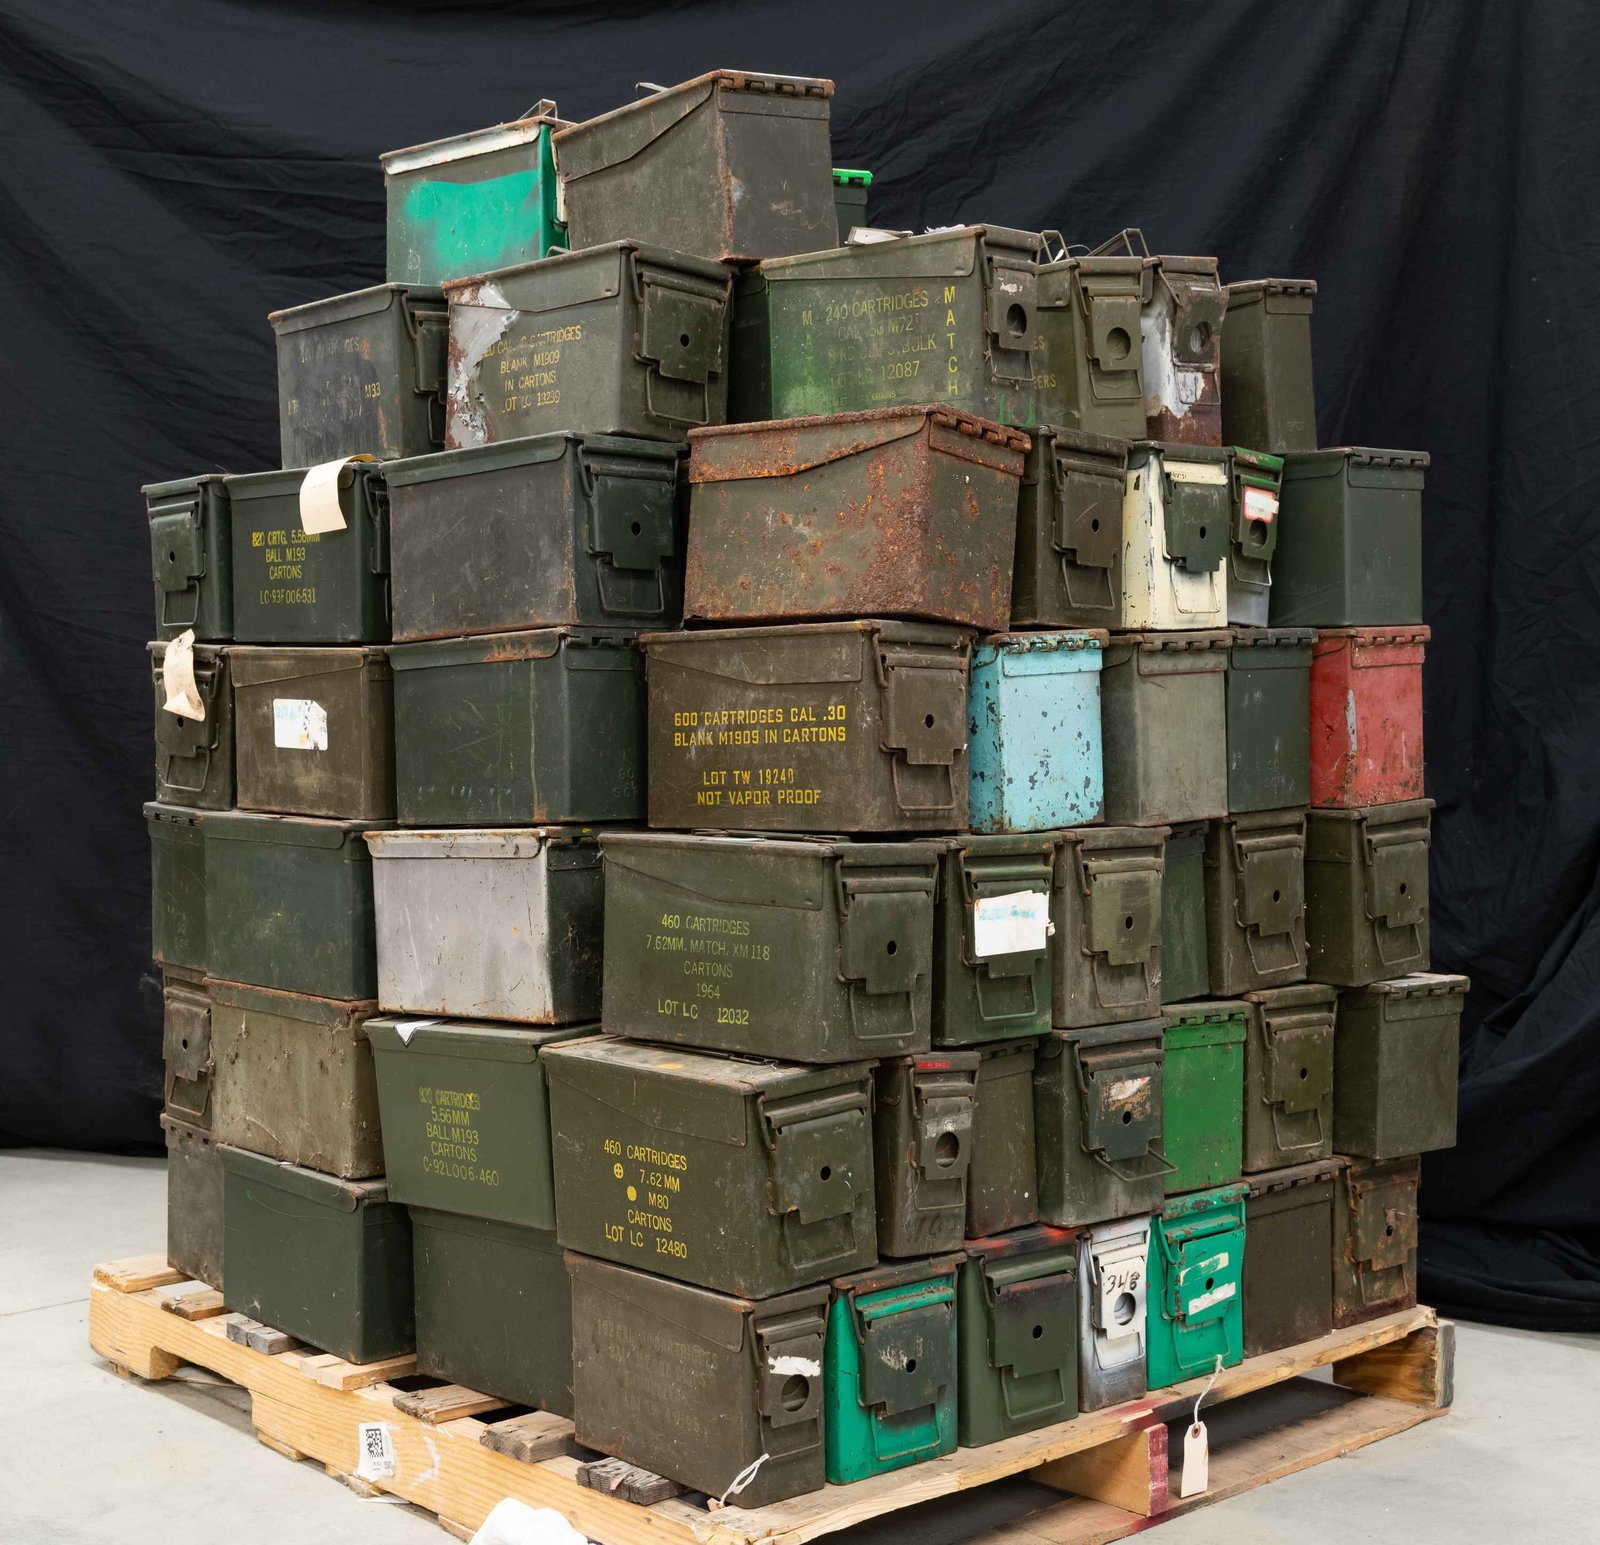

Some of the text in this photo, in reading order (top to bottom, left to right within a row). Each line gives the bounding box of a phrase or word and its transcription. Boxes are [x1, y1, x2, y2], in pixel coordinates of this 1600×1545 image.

[826, 290, 929, 325] 240 CARTRIDGES
[944, 286, 957, 396] MATCH
[500, 350, 560, 375] BLANK M1909
[881, 360, 920, 380] 12087
[505, 370, 557, 391] IN CARTONS
[266, 547, 306, 563] BALL M193
[269, 565, 302, 580] CARTONS
[674, 705, 846, 727] 600 CARTRIDGES CAL .30
[674, 726, 846, 747] BLANK M1909 IN CARTONS
[703, 770, 727, 786] LOT
[733, 770, 750, 785] TW
[697, 789, 821, 806] NOT VAPOR PROOF
[661, 914, 750, 936] 460 CARTRIDGES
[683, 960, 733, 978] CARTONS
[696, 983, 721, 999] 1964
[658, 998, 749, 1025] LOT LC 12032
[435, 1089, 480, 1111] CARTRIDGES
[431, 1106, 470, 1127] 5.56MM
[426, 1122, 479, 1145] BALL M193
[431, 1141, 477, 1162] CARTONS
[603, 1138, 688, 1171] 460 CARTRIDGES
[648, 1191, 669, 1211] M80
[627, 1208, 672, 1233] CARTONS
[605, 1222, 688, 1259] LOT LC 12480
